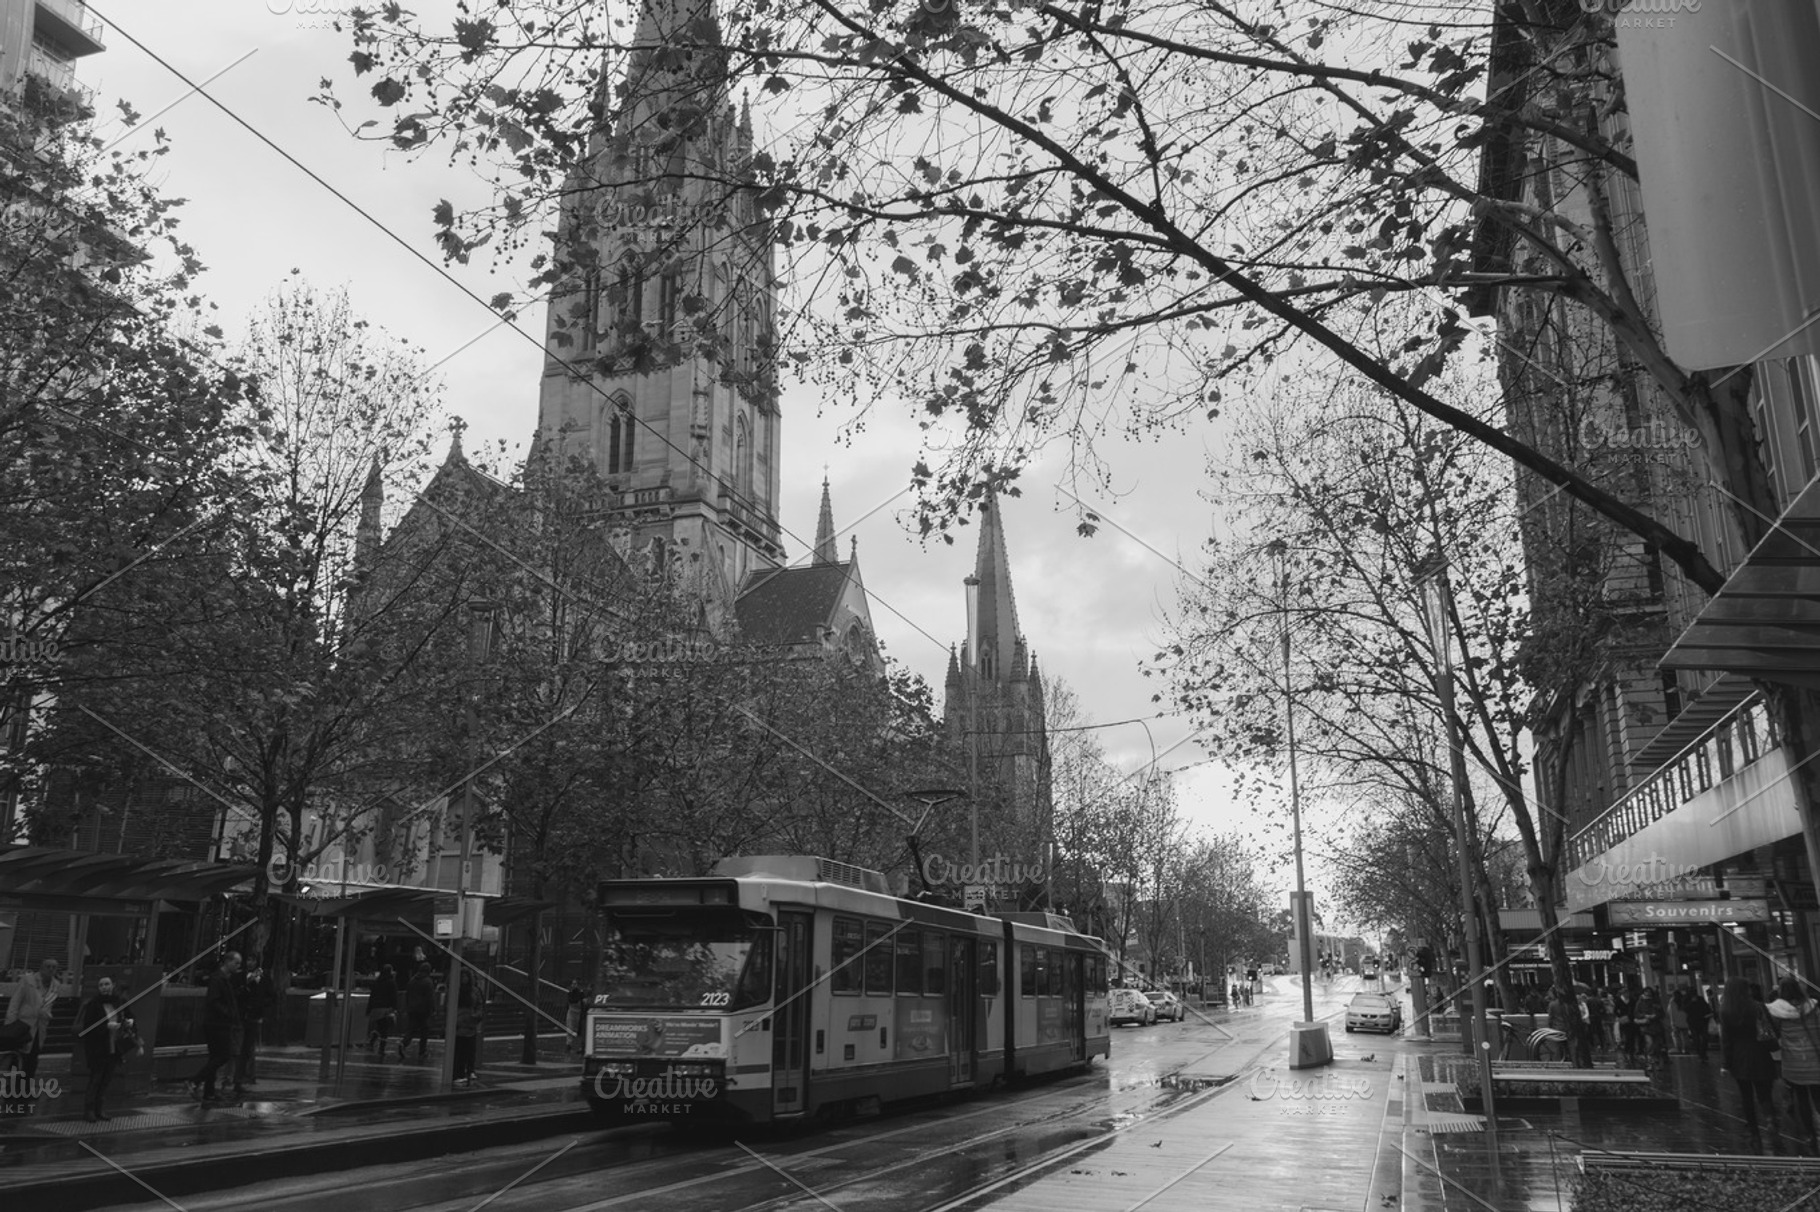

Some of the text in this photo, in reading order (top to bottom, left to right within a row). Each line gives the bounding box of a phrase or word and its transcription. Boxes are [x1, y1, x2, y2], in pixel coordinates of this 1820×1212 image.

[1645, 904, 1733, 917] Souvenirs
[1569, 950, 1618, 960] BWAY
[700, 992, 730, 1006] 2123
